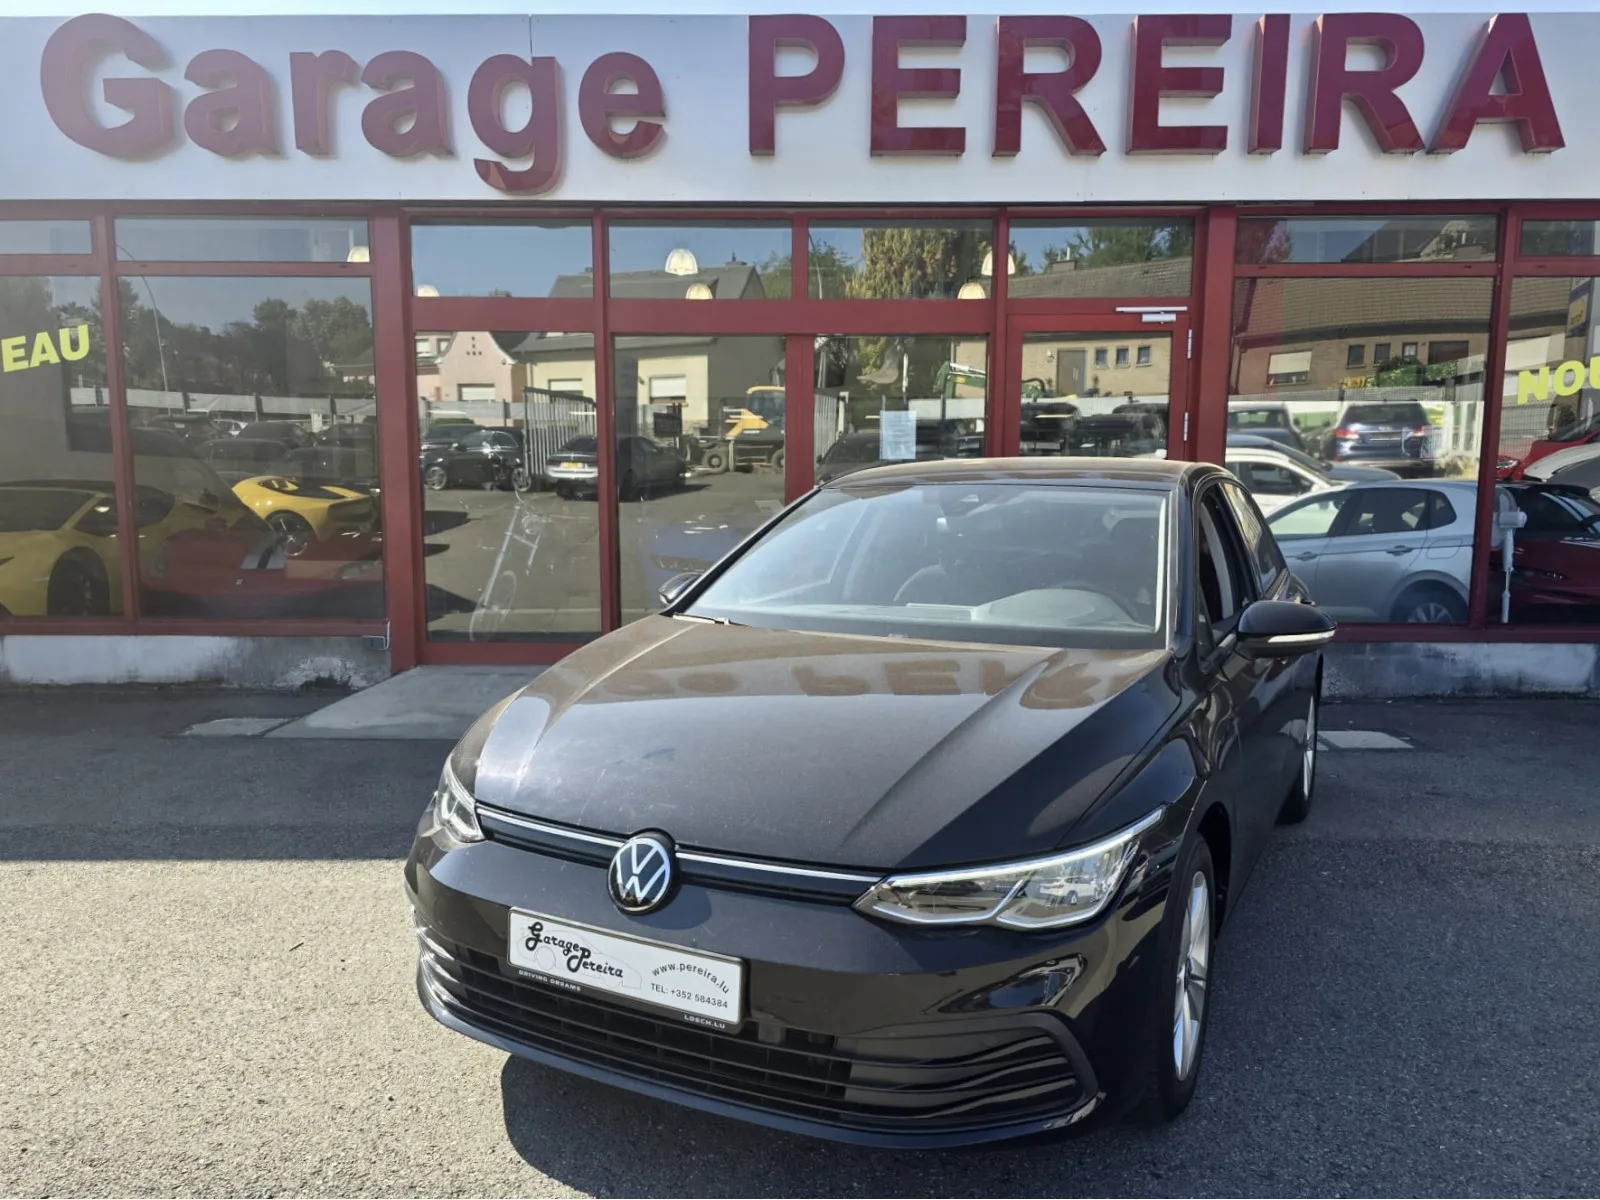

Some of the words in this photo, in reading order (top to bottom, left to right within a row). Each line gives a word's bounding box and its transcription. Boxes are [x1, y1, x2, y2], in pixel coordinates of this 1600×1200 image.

[40, 12, 667, 196] Garage
[748, 12, 1565, 157] PEREIRA
[1, 324, 90, 372] EAU
[525, 921, 580, 957] Garage
[566, 947, 624, 978] Pereira
[650, 983, 669, 994] TEL:
[670, 989, 693, 1001] +352
[652, 963, 730, 994] www.pereira.lu
[684, 1014, 726, 1030] LOSCH.LU
